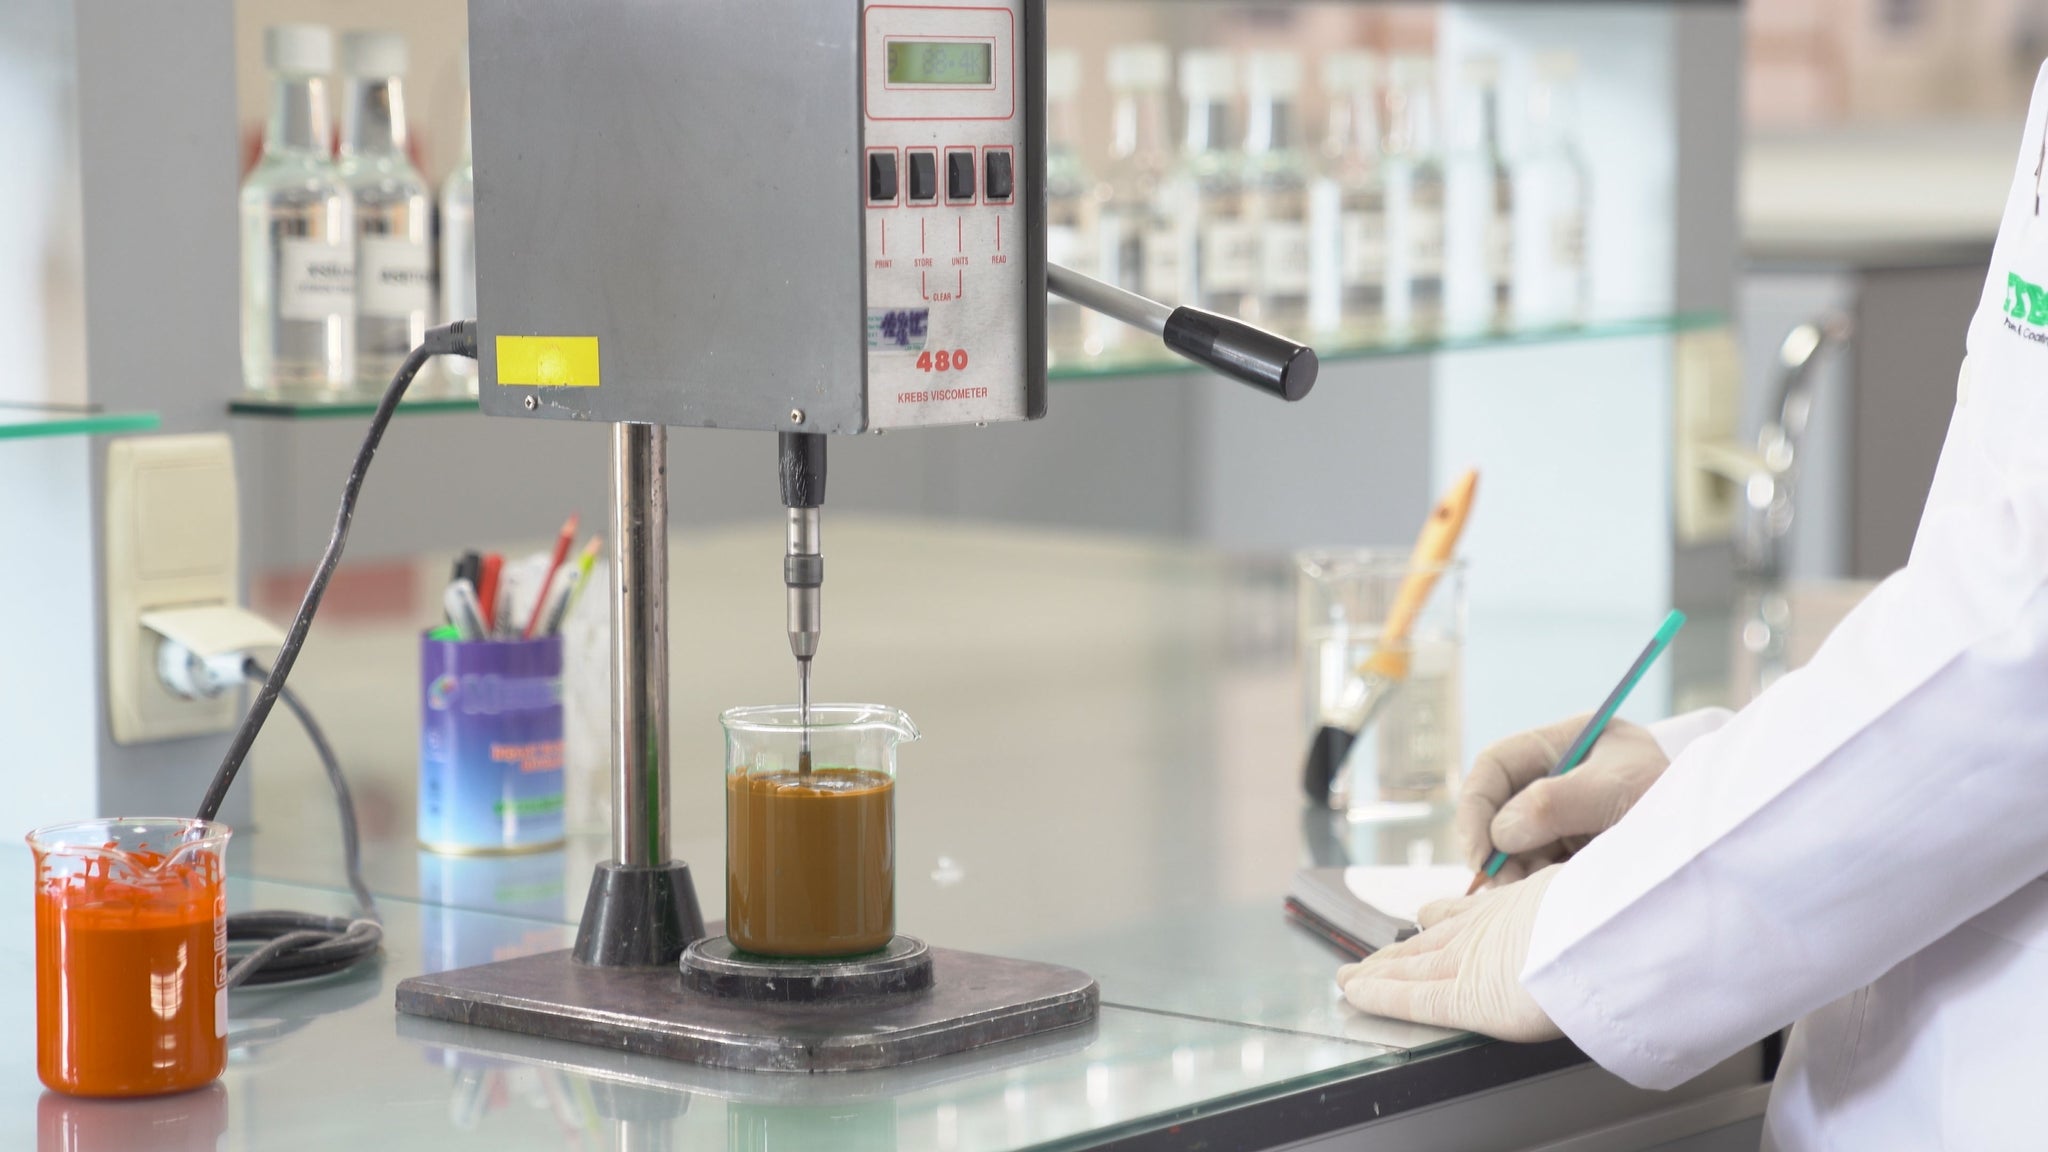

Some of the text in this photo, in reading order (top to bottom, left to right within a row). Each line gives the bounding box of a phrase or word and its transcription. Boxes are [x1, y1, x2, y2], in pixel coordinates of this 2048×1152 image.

[875, 260, 892, 269] PRINT
[914, 258, 933, 267] STORE
[952, 256, 969, 266] UNITS
[991, 255, 1007, 264] READ
[933, 292, 952, 302] CLEAR
[916, 349, 968, 373] 480
[897, 387, 988, 404] KREBS VISCOMETER
